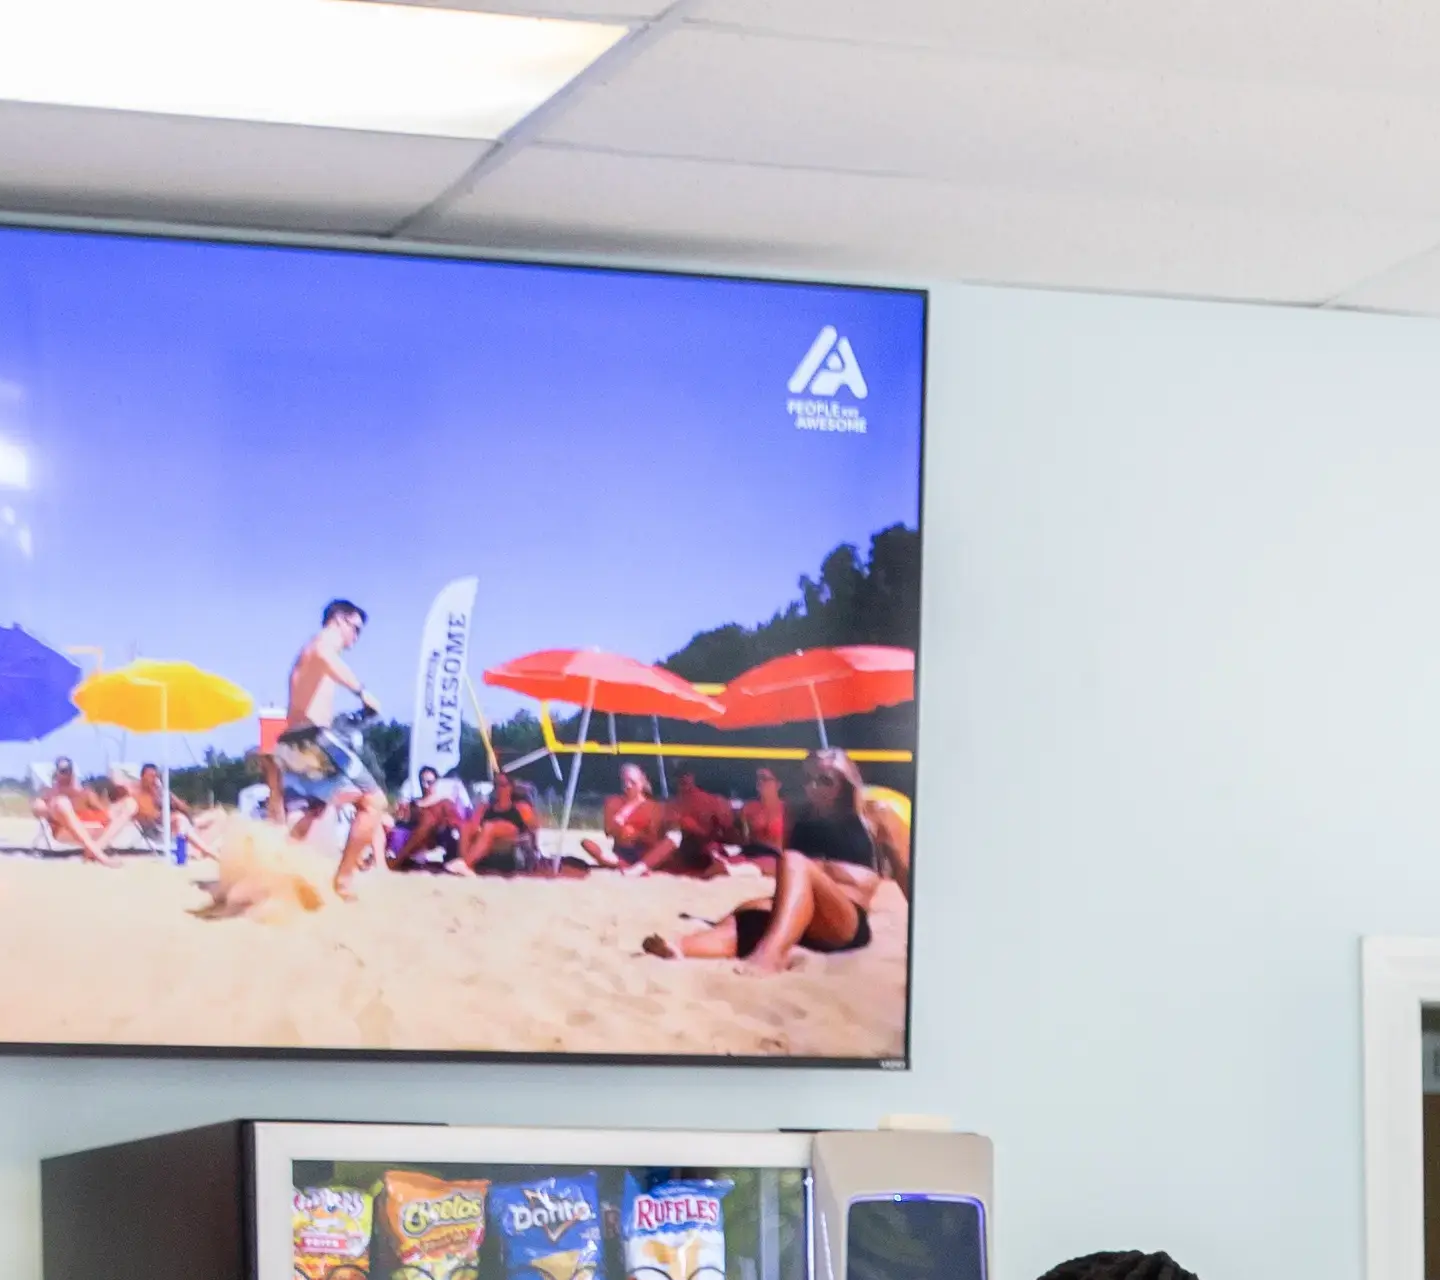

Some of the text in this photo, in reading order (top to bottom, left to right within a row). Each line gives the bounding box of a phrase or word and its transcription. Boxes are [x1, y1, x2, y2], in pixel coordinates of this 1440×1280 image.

[794, 416, 867, 434] AWESOME
[436, 611, 467, 754] AWESOME
[634, 1194, 721, 1230] RUFFLES
